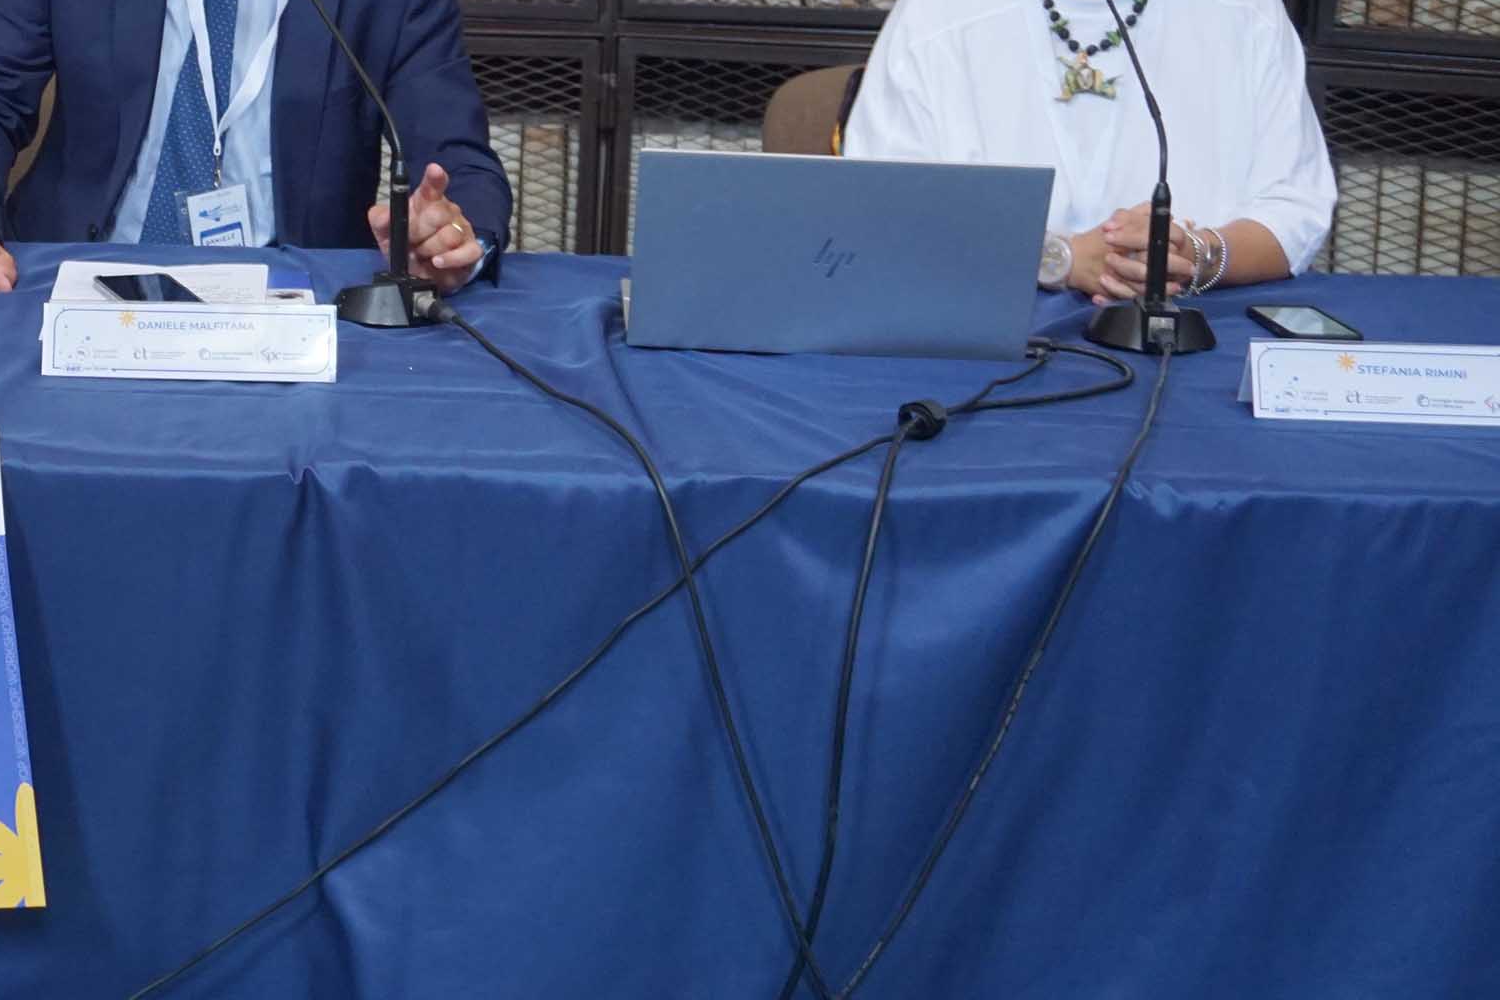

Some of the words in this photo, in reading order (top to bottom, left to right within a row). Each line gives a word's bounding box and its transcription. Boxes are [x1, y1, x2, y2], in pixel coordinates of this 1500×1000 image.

[138, 320, 186, 330] DANIELE
[189, 320, 255, 331] MALFITANA
[1357, 365, 1422, 377] STEFANIA
[1425, 368, 1468, 379] RIMINI
